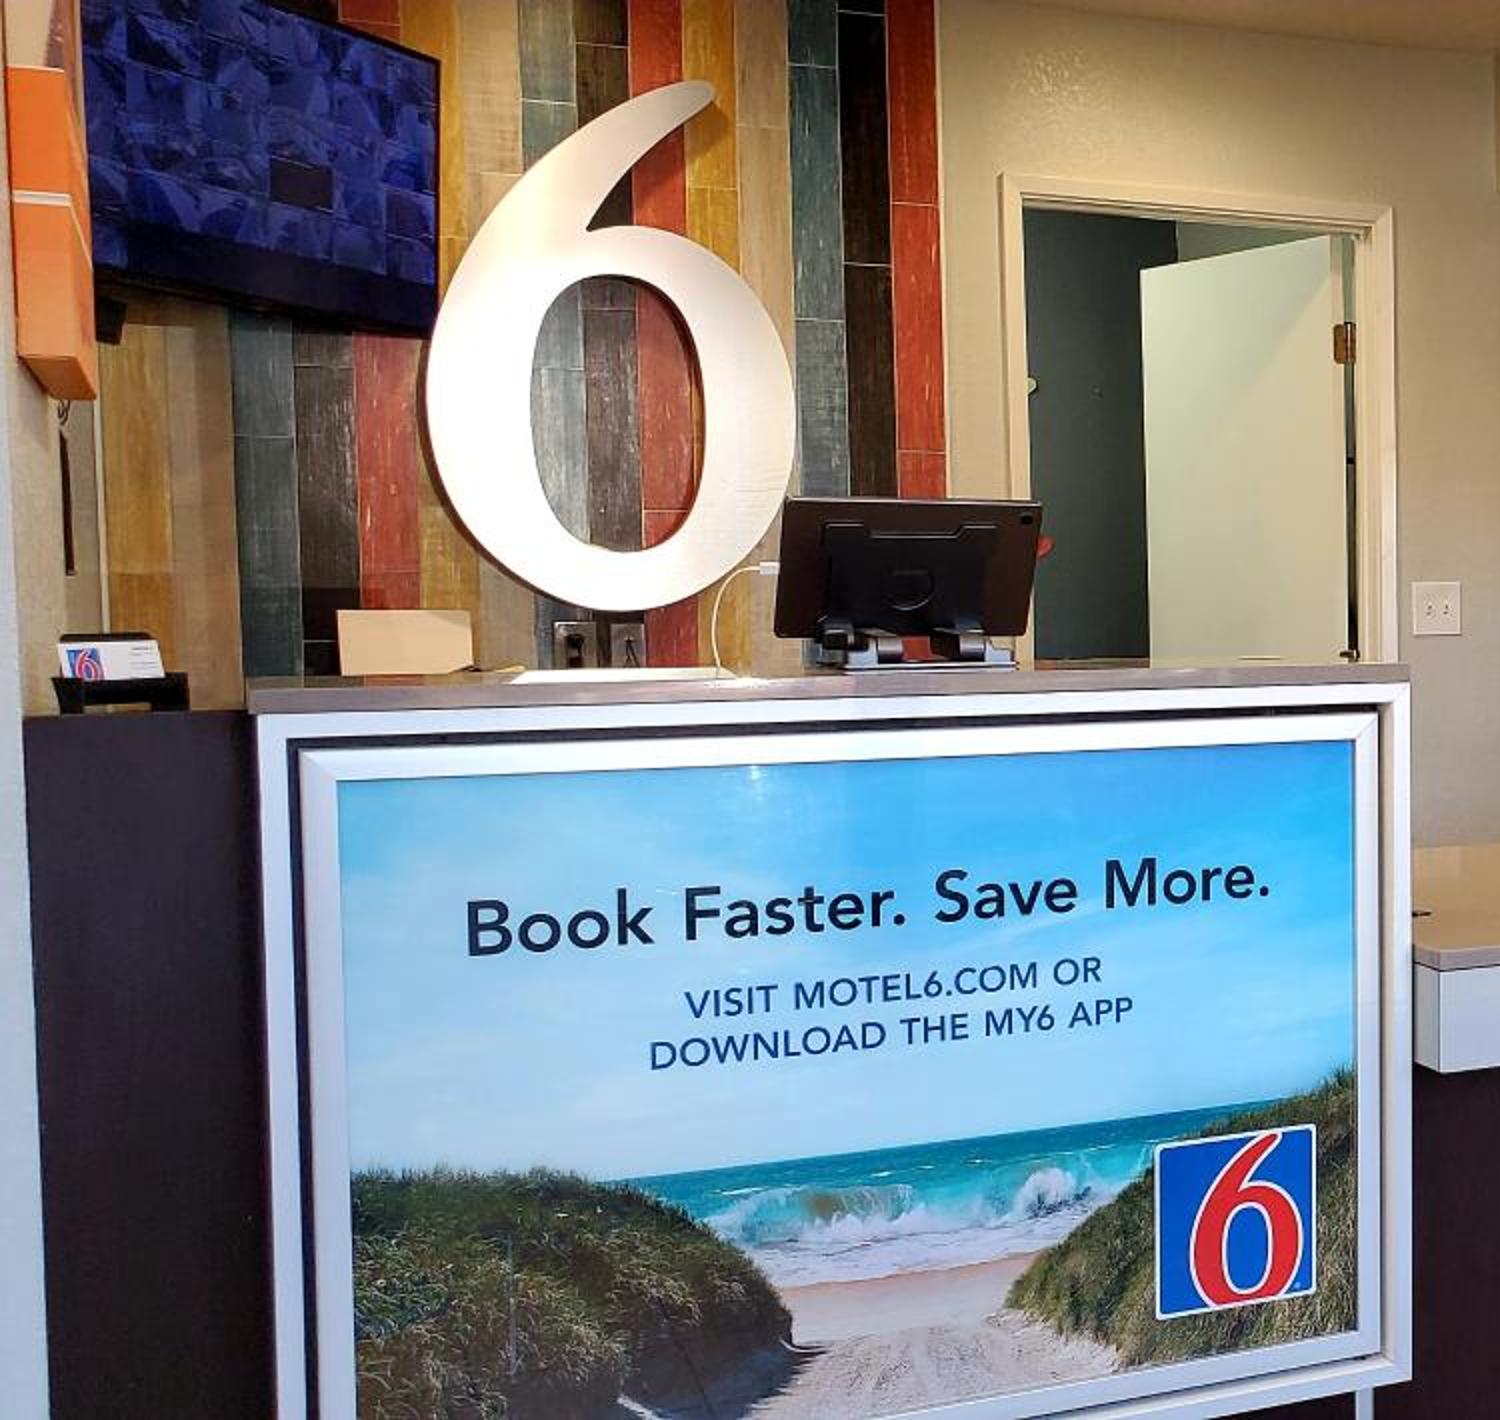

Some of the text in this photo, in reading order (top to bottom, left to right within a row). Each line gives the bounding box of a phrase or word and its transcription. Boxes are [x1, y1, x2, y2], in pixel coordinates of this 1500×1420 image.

[426, 79, 796, 612] 6
[467, 857, 1270, 957] Book Faster. Save More.
[649, 997, 1133, 1070] DOWNLOAD THE MY6 APP
[684, 956, 1101, 1019] VISIT MOTEL6.COM OR
[1190, 1131, 1303, 1309] 6
